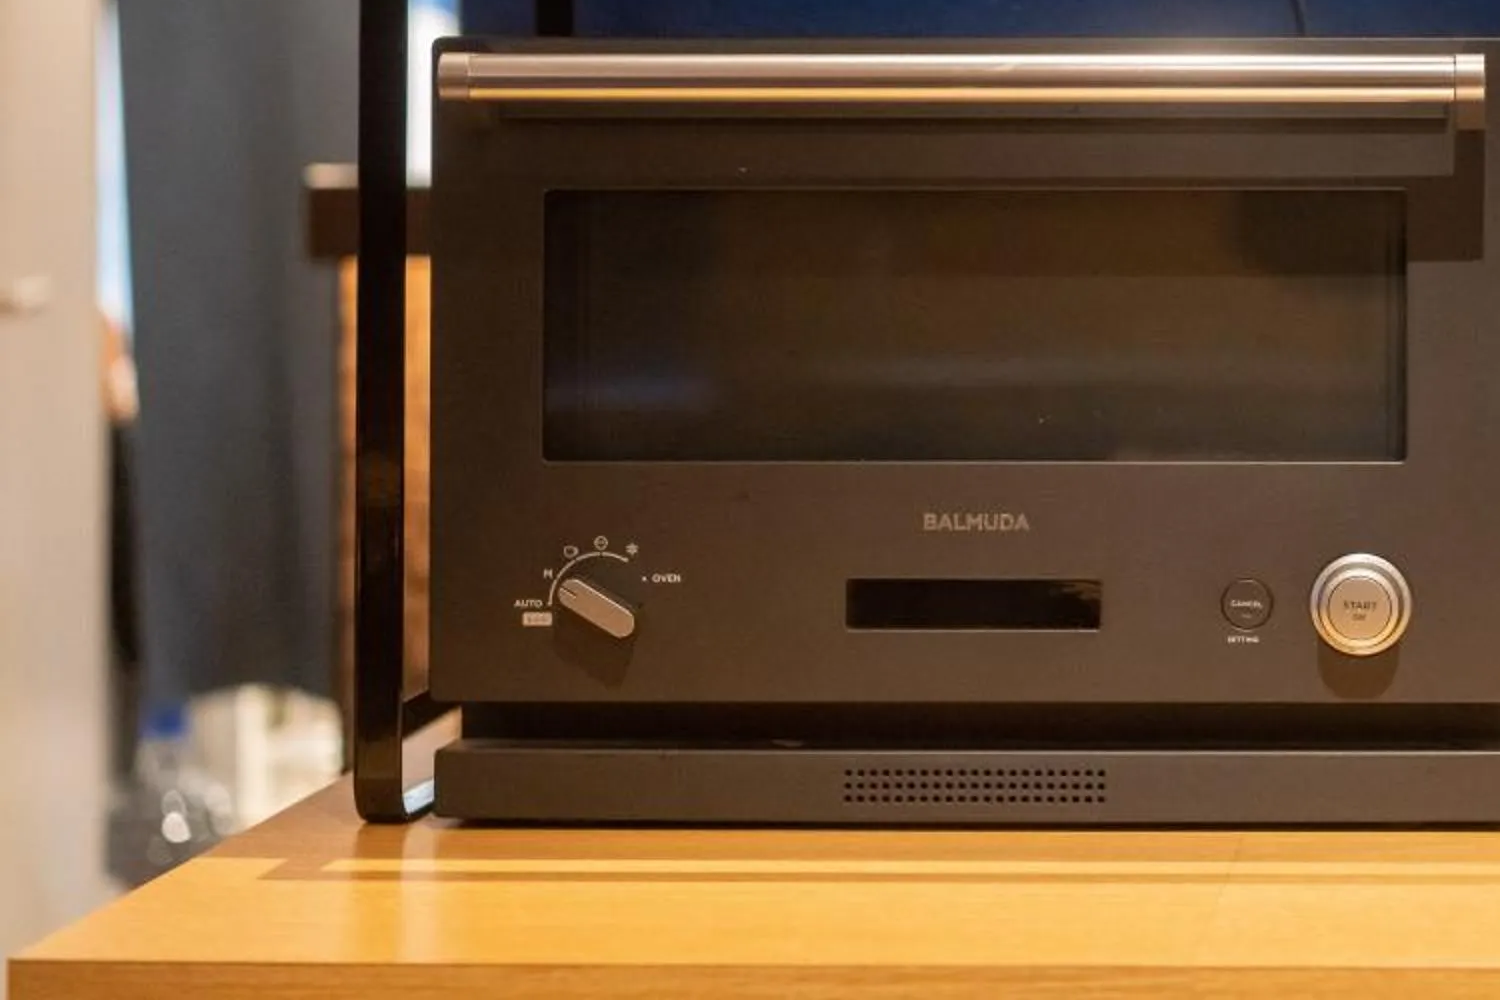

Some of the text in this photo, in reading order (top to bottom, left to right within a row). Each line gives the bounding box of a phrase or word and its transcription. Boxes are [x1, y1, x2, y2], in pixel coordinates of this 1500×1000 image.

[923, 513, 1030, 532] BALMUDA
[651, 573, 681, 583] OVEN
[514, 599, 543, 608] AUTO
[1343, 600, 1377, 610] START
